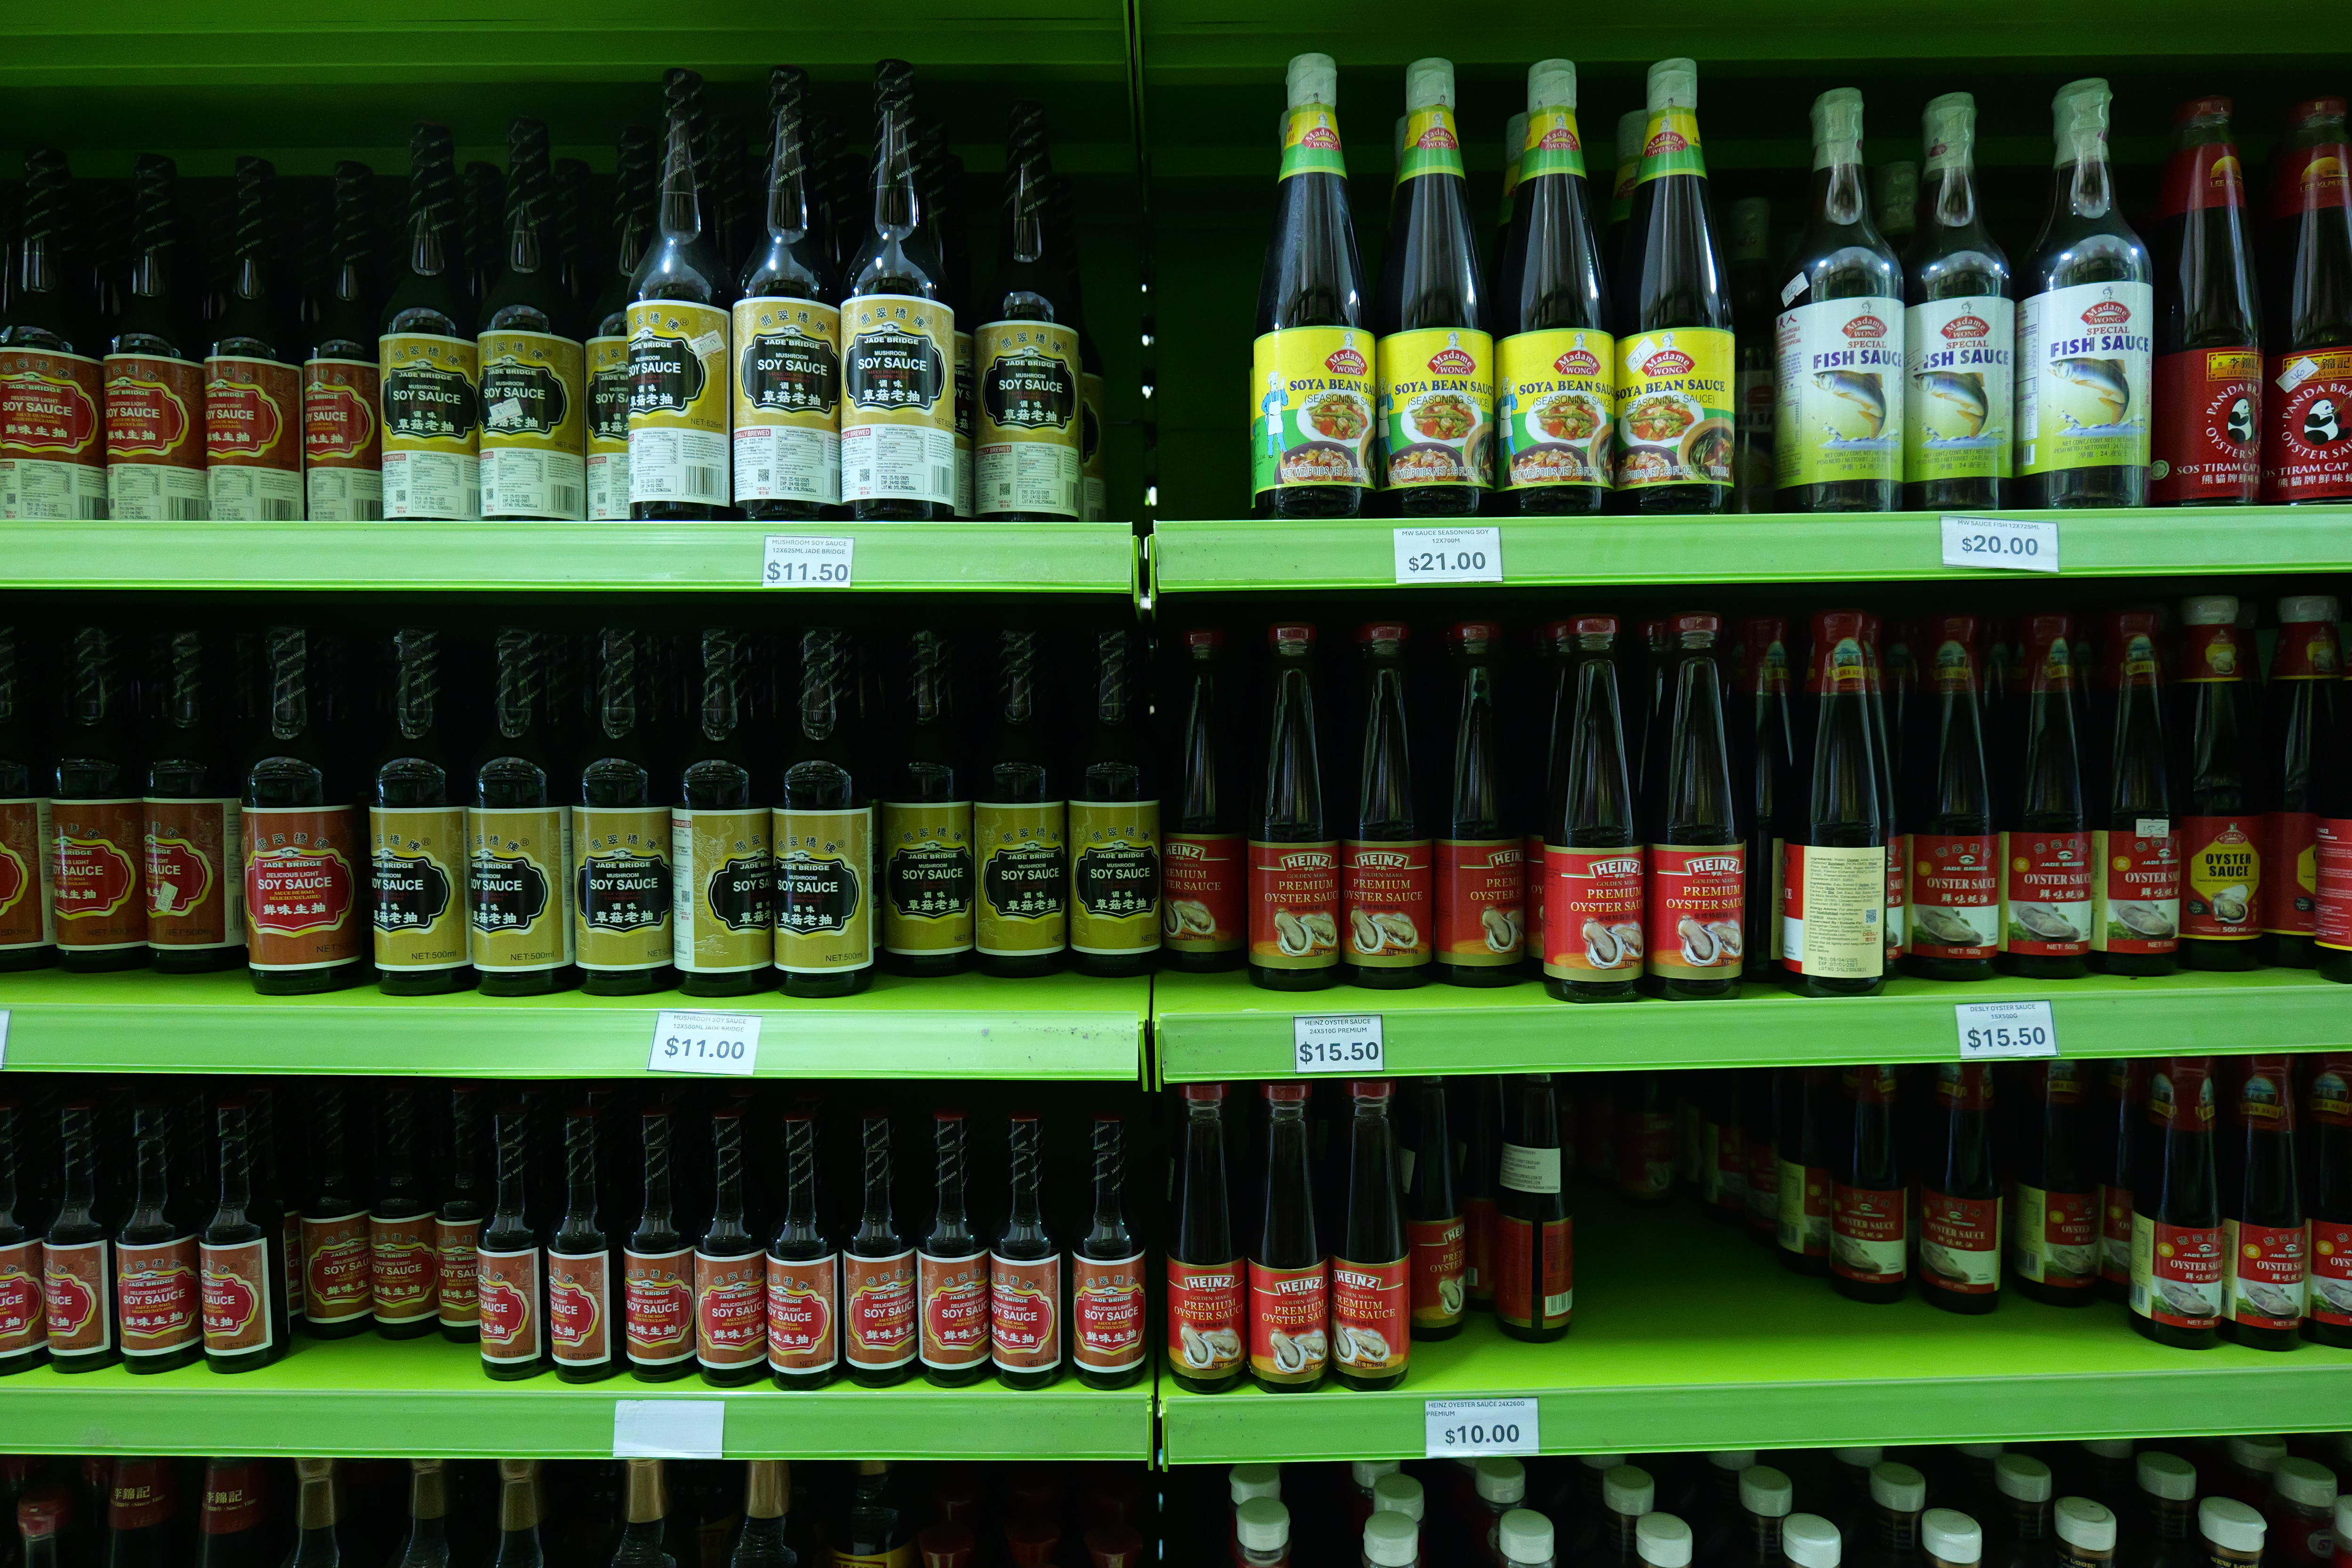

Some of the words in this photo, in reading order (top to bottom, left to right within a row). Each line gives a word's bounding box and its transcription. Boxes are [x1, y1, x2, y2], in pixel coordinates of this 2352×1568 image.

[1306, 129, 1339, 145] Madame
[1313, 140, 1336, 150] WONG
[2086, 303, 2128, 320] Madame
[2086, 326, 2130, 335] SPECIAL
[788, 340, 820, 349] BRIDGE
[2050, 335, 2095, 358] FISH
[2101, 335, 2149, 352] SAUCE
[858, 358, 880, 369] SOY
[883, 358, 927, 372] SAUCE
[1329, 351, 1365, 368] Madame
[1646, 351, 1690, 370] Madame
[1813, 349, 1855, 369] FISH
[1860, 350, 1902, 368] SAUCE
[757, 360, 781, 371] SOY
[785, 361, 827, 376] SAUCE
[1336, 365, 1360, 374] WONG
[1653, 366, 1683, 376] WONG
[421, 372, 452, 381] BRIDGE
[29, 385, 62, 393] BRIDGE
[999, 379, 1020, 390] SOY
[1025, 379, 1063, 393] SAUCE
[1289, 379, 1325, 391] SOYA
[1328, 379, 1362, 391] BEAN
[1395, 382, 1428, 395] SOYA
[1431, 379, 1468, 391] BEAN
[1615, 386, 1642, 401] SOYA
[1645, 380, 1685, 395] BEAN
[1688, 380, 1725, 391] SAUCE
[393, 390, 416, 401] SOY
[418, 391, 461, 405] SAUCE
[1304, 394, 1358, 405] (SEASONING
[1625, 395, 1679, 410] (SEASONING
[1683, 394, 1715, 405] SAUCE)
[2206, 383, 2245, 415] PANDA
[2, 402, 24, 411] SOY
[26, 403, 72, 416] SAUCE
[707, 420, 723, 429] 625ml
[2206, 427, 2246, 459] OYSTER
[2279, 464, 2320, 476] TIRAM
[2324, 462, 2349, 471] CAP
[1962, 535, 2038, 556] $20.00
[1409, 552, 1486, 573] $21.00
[767, 560, 848, 581] $11.50
[1288, 856, 1328, 868] HEINZ
[2206, 854, 2251, 864] OYSTER
[1693, 860, 1737, 873] HEINZ
[2209, 866, 2249, 876] SAUCE
[902, 870, 925, 880] SOY
[928, 868, 963, 879] SAUCE
[258, 878, 282, 890] SOY
[285, 876, 332, 889] SAUCE
[590, 879, 612, 890] SOY
[616, 877, 658, 890] SAUCE
[778, 881, 794, 892] SOY
[796, 881, 838, 893] SAUCE
[1279, 880, 1333, 890] PREMIUM
[1927, 877, 1969, 889] OYSTER
[1264, 893, 1307, 903] OYSTER
[1344, 890, 1391, 901] OYSTER
[1392, 891, 1422, 901] SAUCE
[1968, 1027, 2045, 1050] $15.50
[665, 1035, 744, 1059] $11.00
[1299, 1042, 1379, 1065] $15.50
[1191, 1278, 1232, 1288] HEINZ
[123, 1296, 142, 1305] SOY
[145, 1289, 186, 1304] SAUCE
[627, 1300, 641, 1312] SOY
[644, 1302, 680, 1313] SAUCE
[1184, 1299, 1236, 1310] PREMIUM
[1085, 1310, 1104, 1318] SOY
[1107, 1305, 1138, 1321] SAUCE
[1174, 1306, 1214, 1321] OYSTER
[1359, 1309, 1395, 1318] SAUCE
[1445, 1425, 1519, 1445] $10.00
